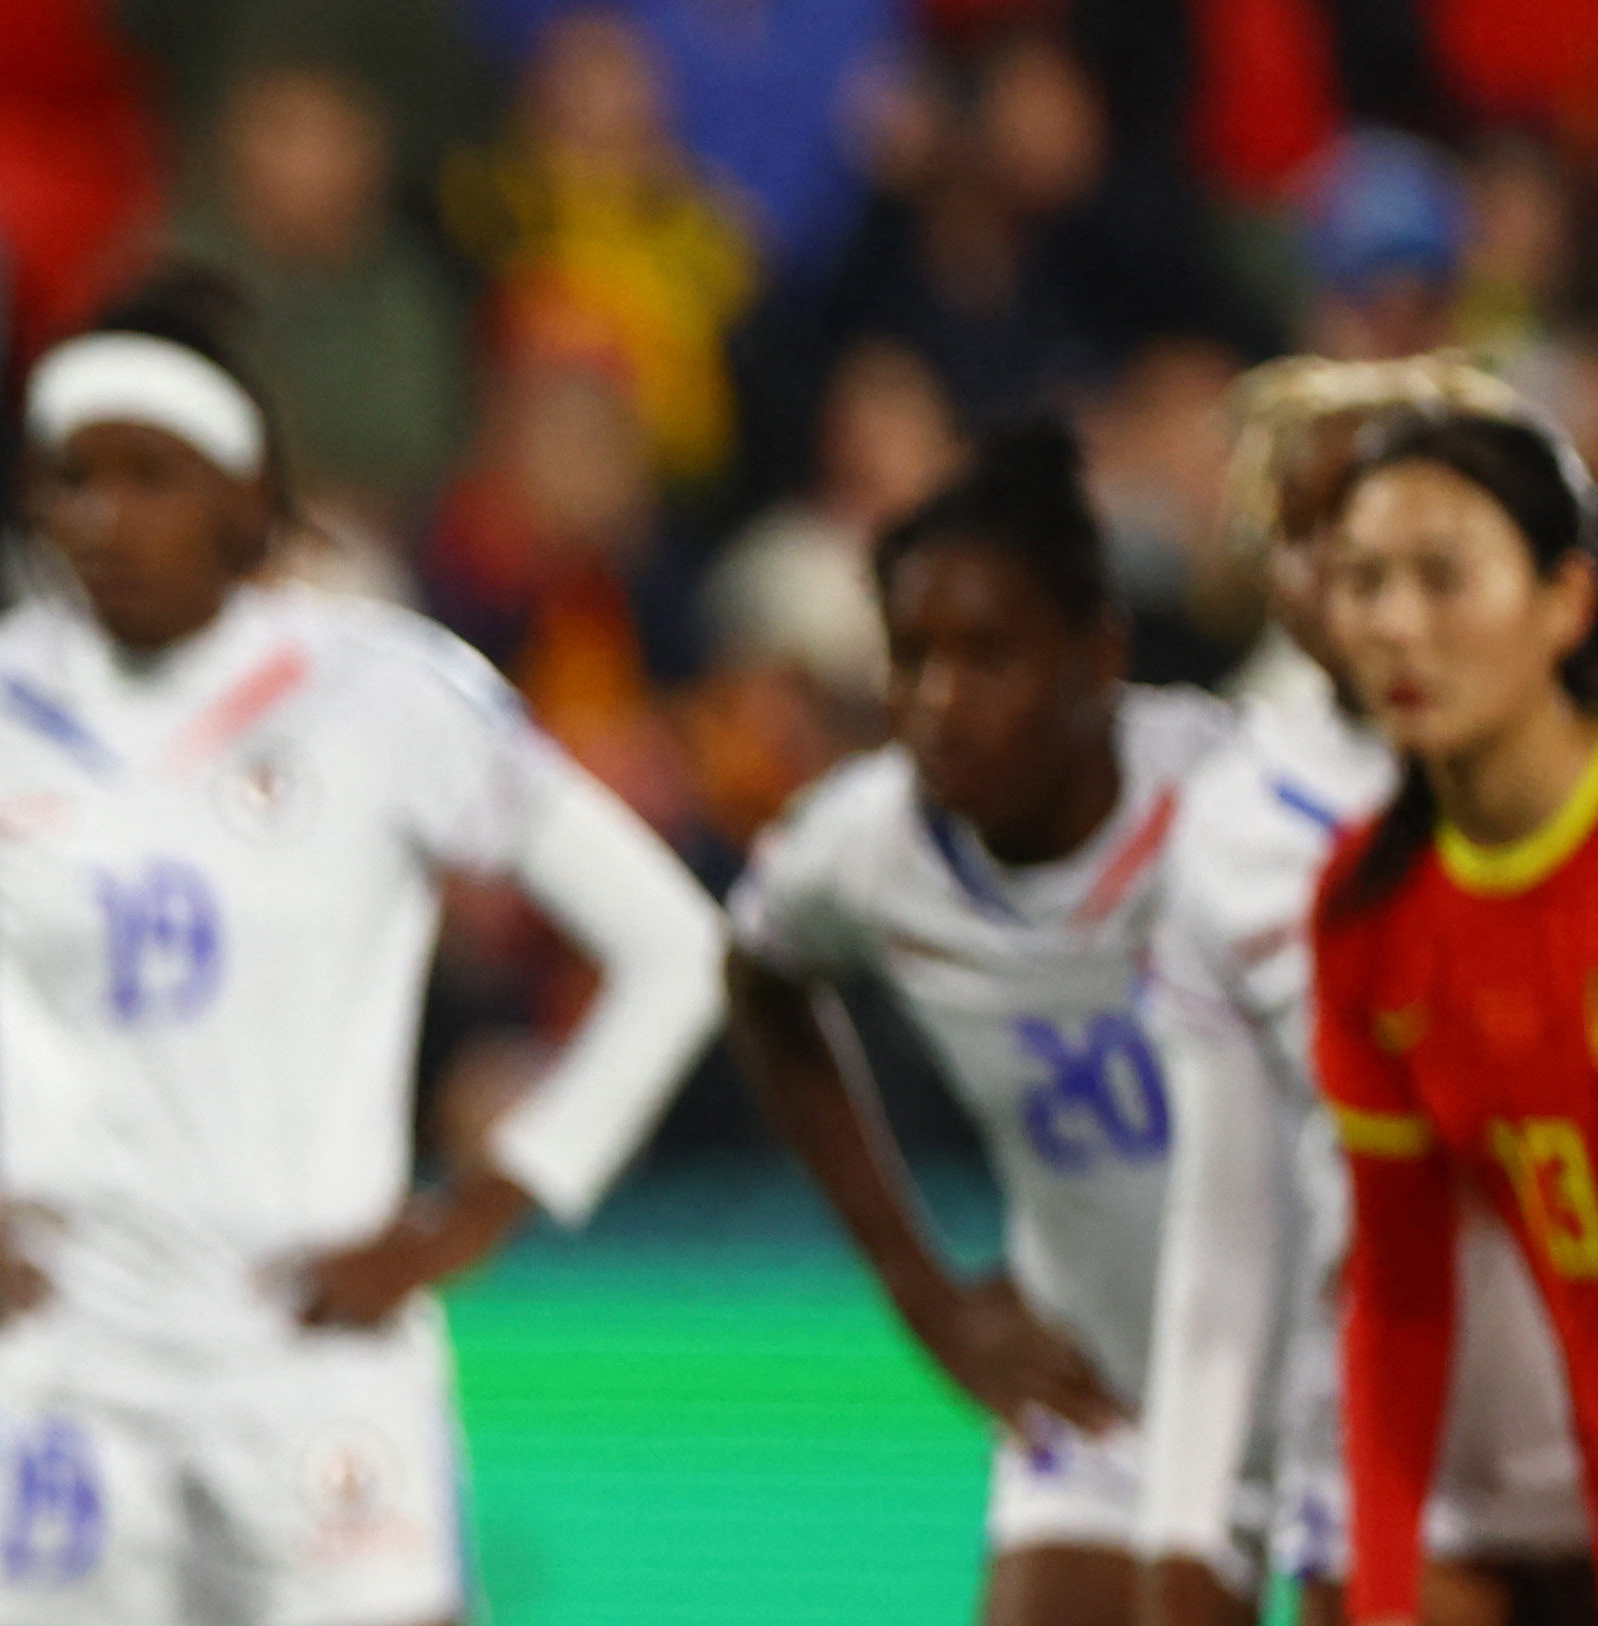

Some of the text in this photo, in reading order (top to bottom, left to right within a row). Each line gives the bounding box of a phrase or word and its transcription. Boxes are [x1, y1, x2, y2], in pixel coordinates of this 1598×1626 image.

[91, 856, 226, 1028] 19
[1012, 1012, 1172, 1172] 20
[1487, 1114, 1598, 1280] 13
